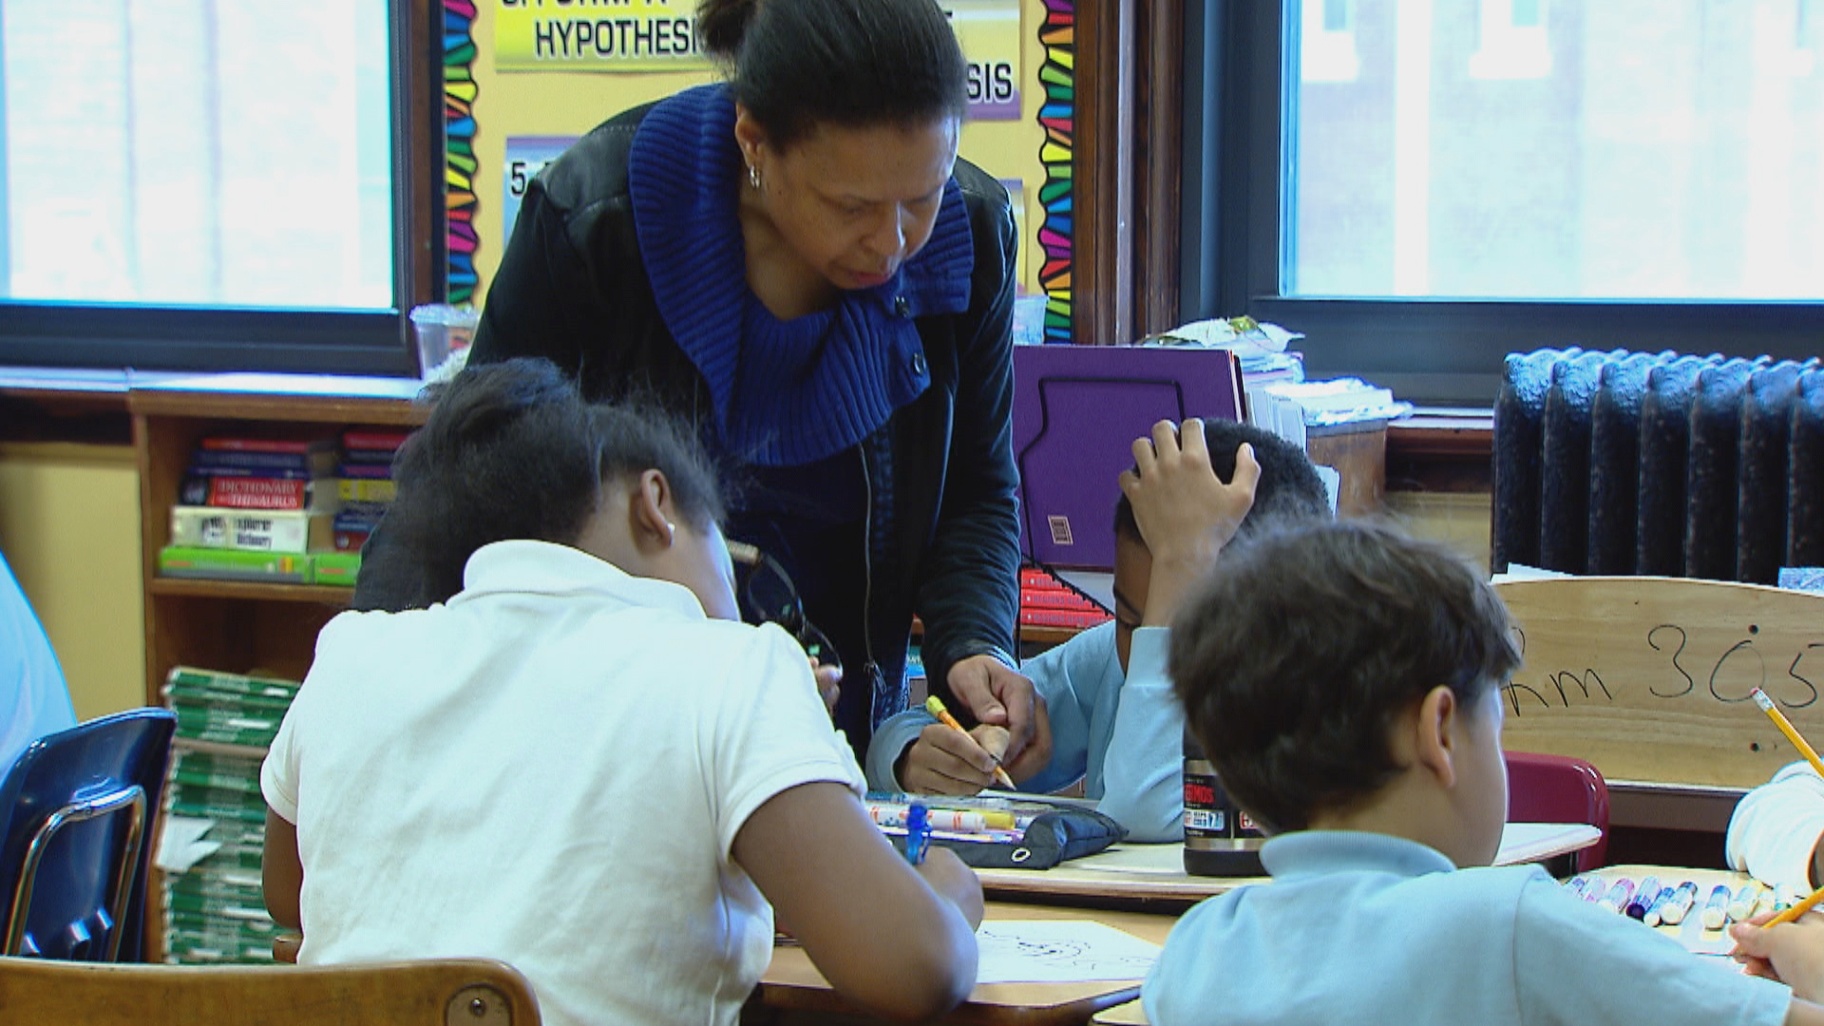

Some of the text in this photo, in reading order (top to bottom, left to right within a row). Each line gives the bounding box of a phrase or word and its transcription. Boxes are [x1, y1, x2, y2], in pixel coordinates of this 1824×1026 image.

[535, 19, 698, 56] HYPOTHESI
[966, 63, 1012, 100] SIS
[218, 480, 297, 495] DICTIONARY
[230, 494, 297, 506] THESAURUS
[1648, 624, 1824, 708] 305
